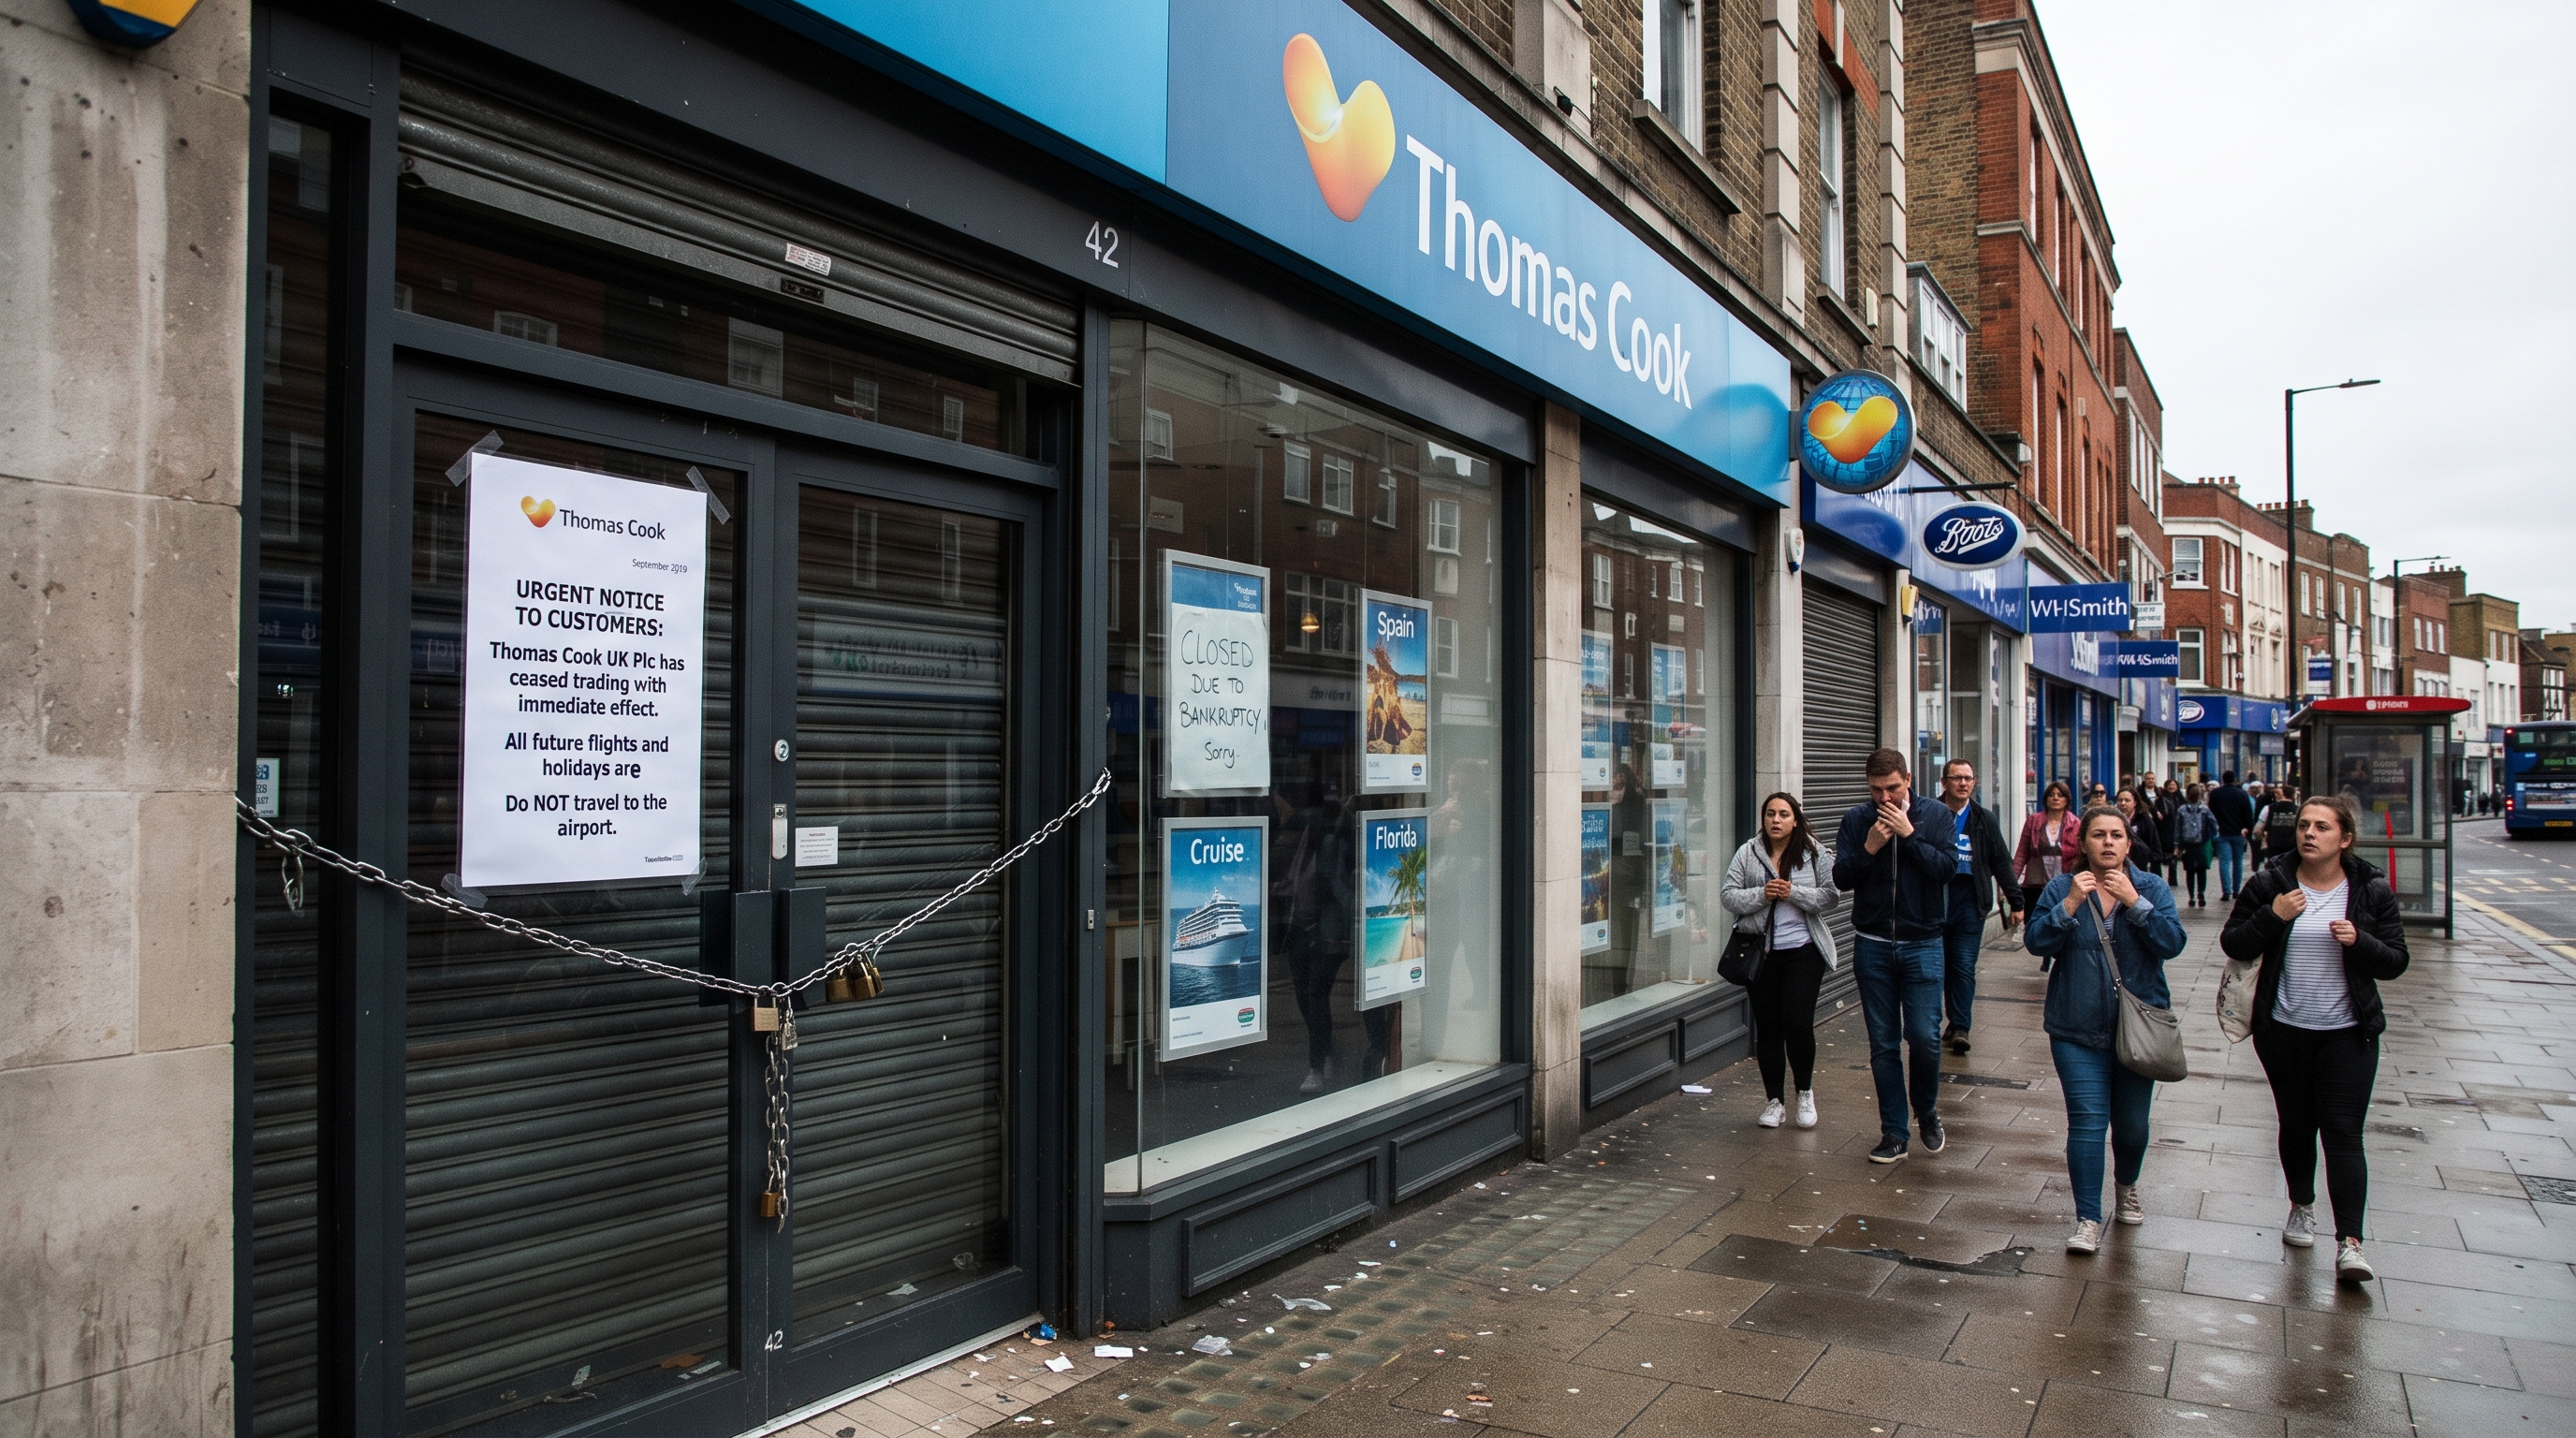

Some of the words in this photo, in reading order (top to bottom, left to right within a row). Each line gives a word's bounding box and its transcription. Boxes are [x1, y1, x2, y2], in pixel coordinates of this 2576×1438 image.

[1085, 221, 1119, 269] 42
[1406, 134, 1598, 351] Thomas
[1607, 280, 1692, 410] Cook
[559, 508, 624, 535] Thomas
[627, 519, 666, 540] Cook
[1934, 516, 2004, 555] Boots
[632, 558, 669, 571] September
[516, 579, 595, 605] URGENT
[599, 587, 665, 612] NOTICE
[2030, 596, 2128, 618] WHSmith
[515, 606, 542, 627] TO
[547, 609, 664, 638] CUSTOMERS:
[1378, 610, 1414, 641] Spain
[489, 640, 558, 663] Thomas
[562, 646, 603, 666] Cook
[607, 650, 629, 668] UK
[633, 652, 657, 668] Plc
[660, 653, 685, 671] has
[1180, 629, 1254, 668] CLOSED
[509, 670, 569, 689] ceased
[572, 672, 630, 696] trading
[634, 675, 667, 694] with
[1191, 673, 1220, 694] DUE
[1227, 677, 1244, 694] TO
[518, 693, 607, 715] immediate
[609, 698, 659, 717] effect.
[504, 731, 527, 751] All
[532, 732, 584, 752] future
[587, 733, 638, 756] flights
[641, 735, 669, 753] and
[542, 757, 610, 781] holidays
[614, 763, 641, 779] are
[505, 794, 529, 813] Do
[534, 794, 570, 812] NOT
[573, 793, 620, 812] travel
[622, 794, 639, 811] to
[642, 792, 667, 811] the
[557, 818, 618, 841] airport.
[1376, 823, 1417, 850] Florida
[1191, 836, 1245, 865] Cruise
[764, 1328, 783, 1353] 42
